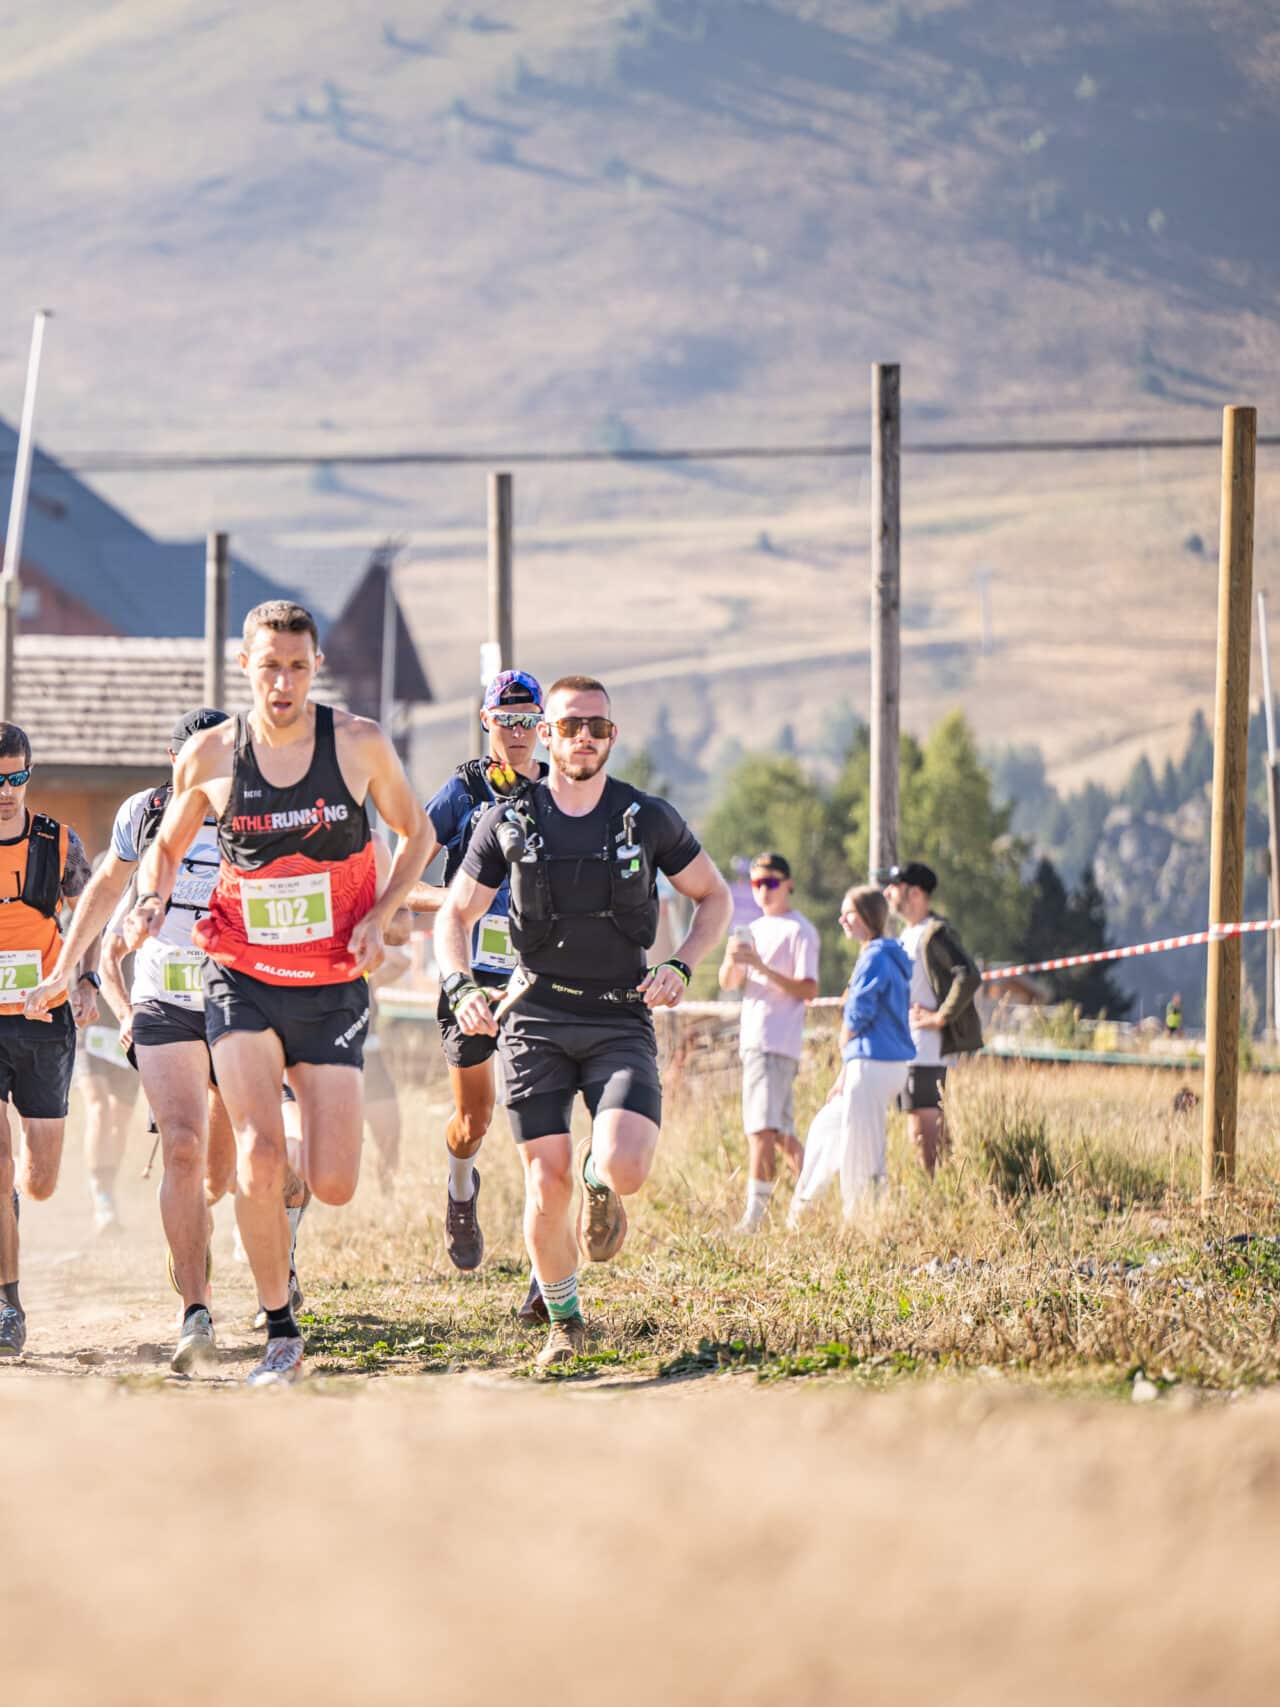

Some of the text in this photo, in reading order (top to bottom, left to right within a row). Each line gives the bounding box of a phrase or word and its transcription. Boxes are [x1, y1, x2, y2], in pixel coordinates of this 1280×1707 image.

[231, 802, 349, 833] ATHLERUNNING
[263, 897, 309, 927] 102
[254, 962, 315, 978] SALOMON
